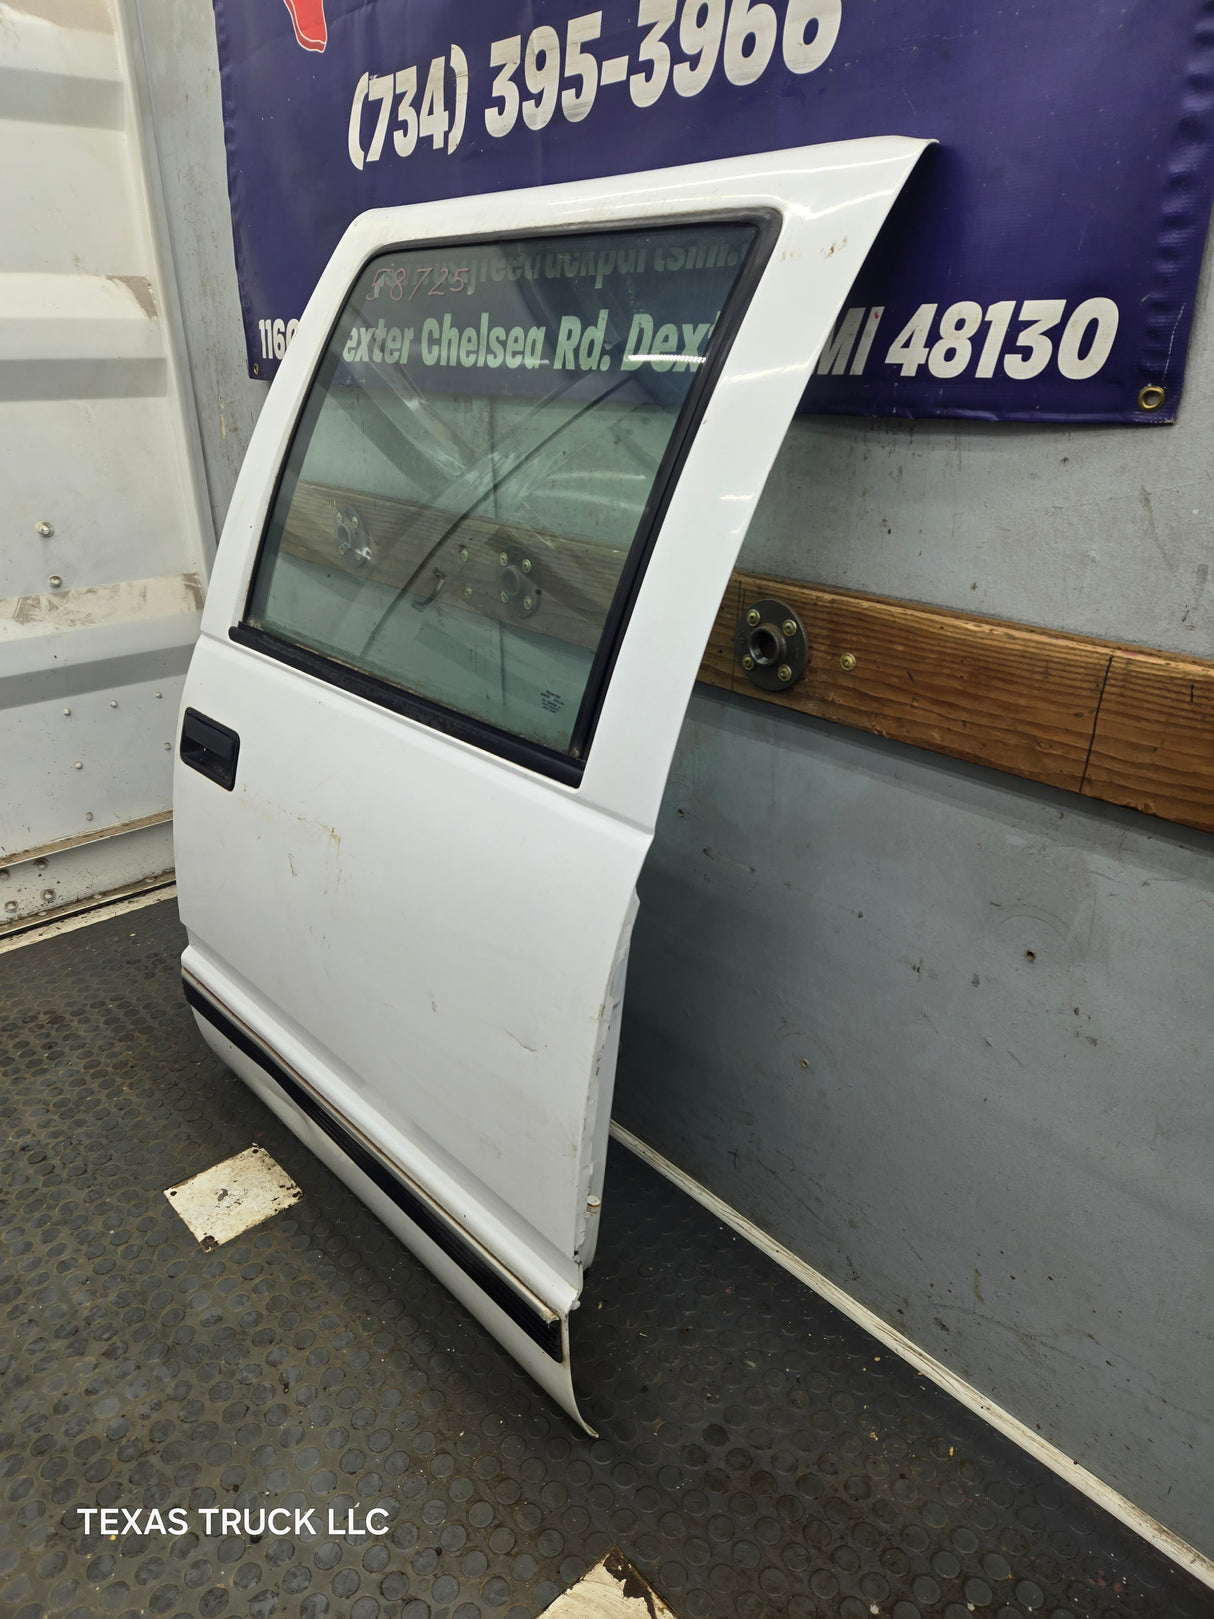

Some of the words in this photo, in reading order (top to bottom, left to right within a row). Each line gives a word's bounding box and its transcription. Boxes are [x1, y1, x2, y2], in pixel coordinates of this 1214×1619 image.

[348, 44, 468, 170] (734)
[485, 0, 842, 137] 395-3966
[342, 318, 415, 364] exter
[421, 312, 546, 368] Chelsea
[553, 308, 611, 371] Rd.
[620, 310, 721, 373] Dex
[884, 297, 1119, 380] 48130
